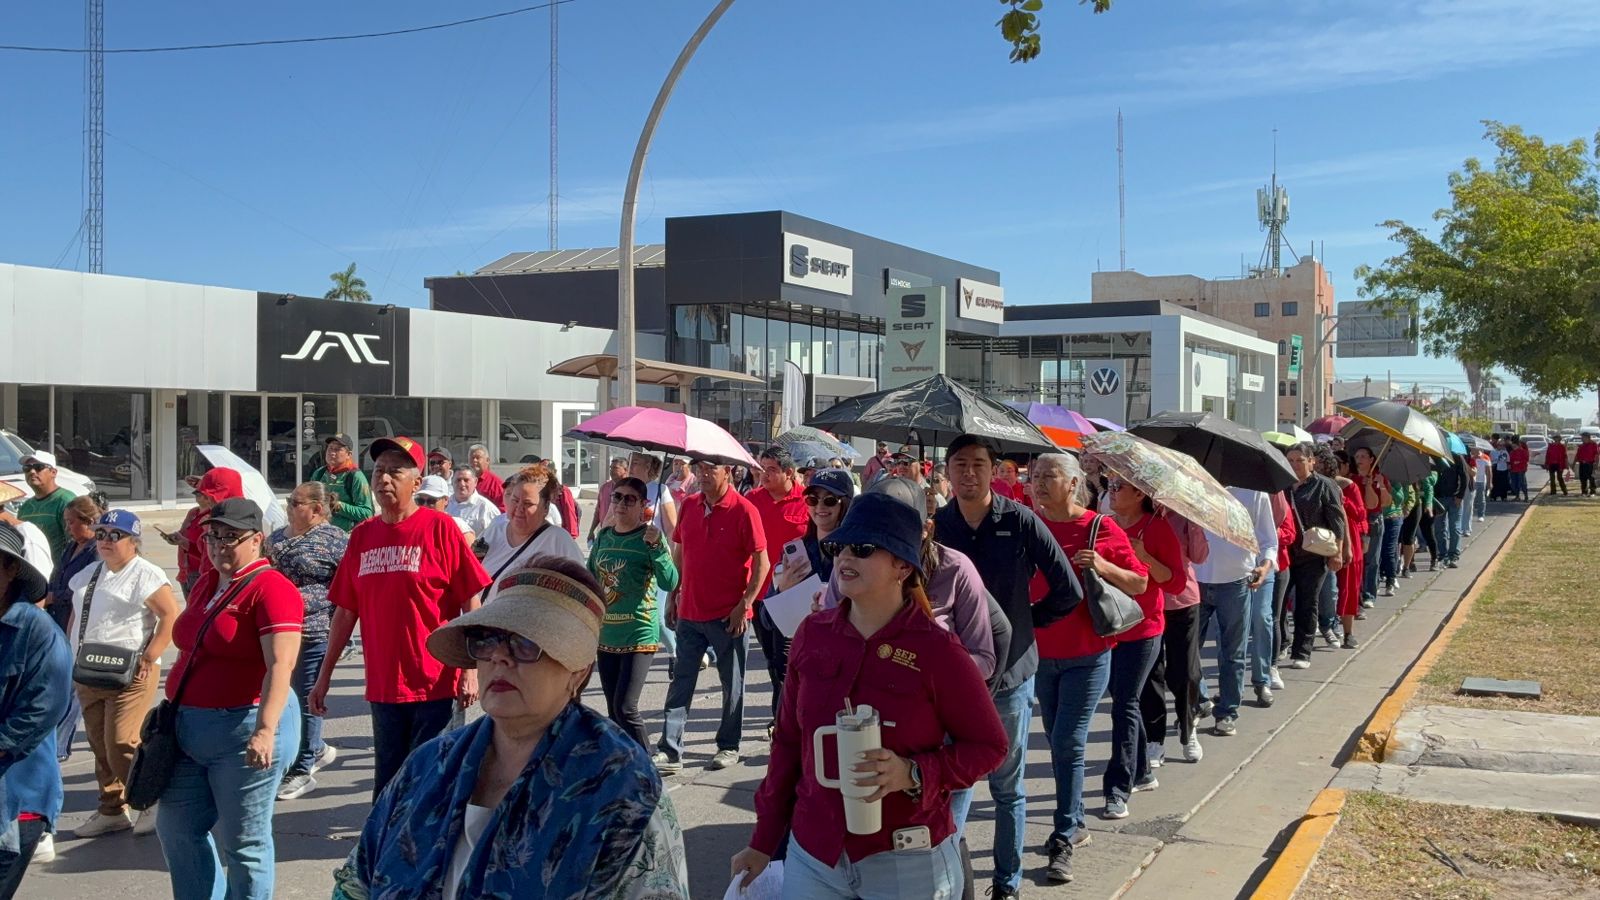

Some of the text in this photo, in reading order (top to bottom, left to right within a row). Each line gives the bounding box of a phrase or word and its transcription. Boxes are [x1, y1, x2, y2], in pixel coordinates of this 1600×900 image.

[810, 256, 850, 279] SEAT
[892, 322, 935, 331] SEAT
[280, 330, 390, 365] JAC
[86, 654, 125, 666] GUESS
[894, 648, 917, 661] SEP
